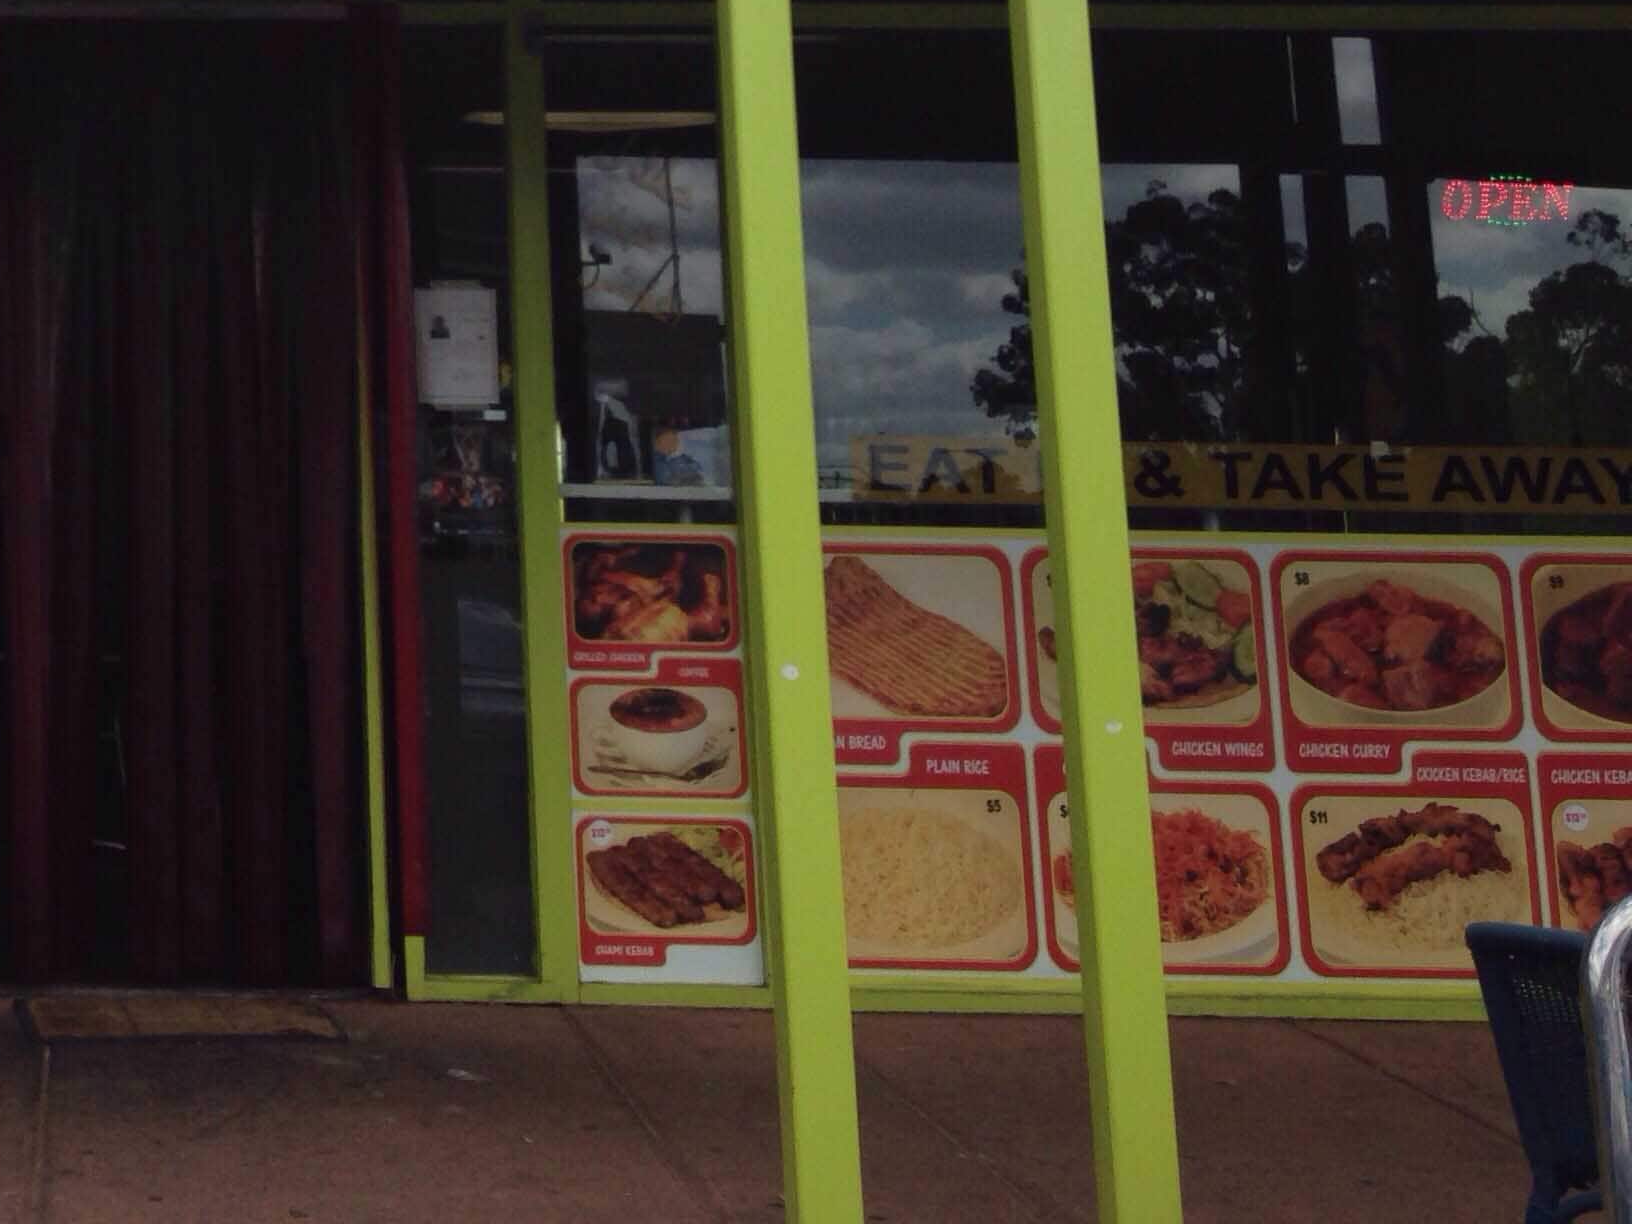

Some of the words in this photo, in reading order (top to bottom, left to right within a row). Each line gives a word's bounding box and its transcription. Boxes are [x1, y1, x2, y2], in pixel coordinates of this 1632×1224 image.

[1440, 180, 1574, 221] OPEN
[867, 444, 1010, 497] EAT
[1133, 450, 1186, 498] &
[1210, 451, 1410, 502] TAKE
[848, 734, 887, 751] BREAD
[1171, 741, 1222, 758] CHICKEN
[1224, 742, 1265, 758] WINGS
[1298, 743, 1349, 759] CHICKEN
[1352, 744, 1392, 760] CURRY
[925, 759, 961, 775] PLAIN
[963, 760, 991, 775] RICE
[1416, 767, 1461, 783] CHICKEN
[1462, 767, 1527, 783] KEBAB/RICE
[1550, 768, 1601, 784] CHICKEN
[986, 799, 1002, 813] $5
[1309, 810, 1328, 824] $11
